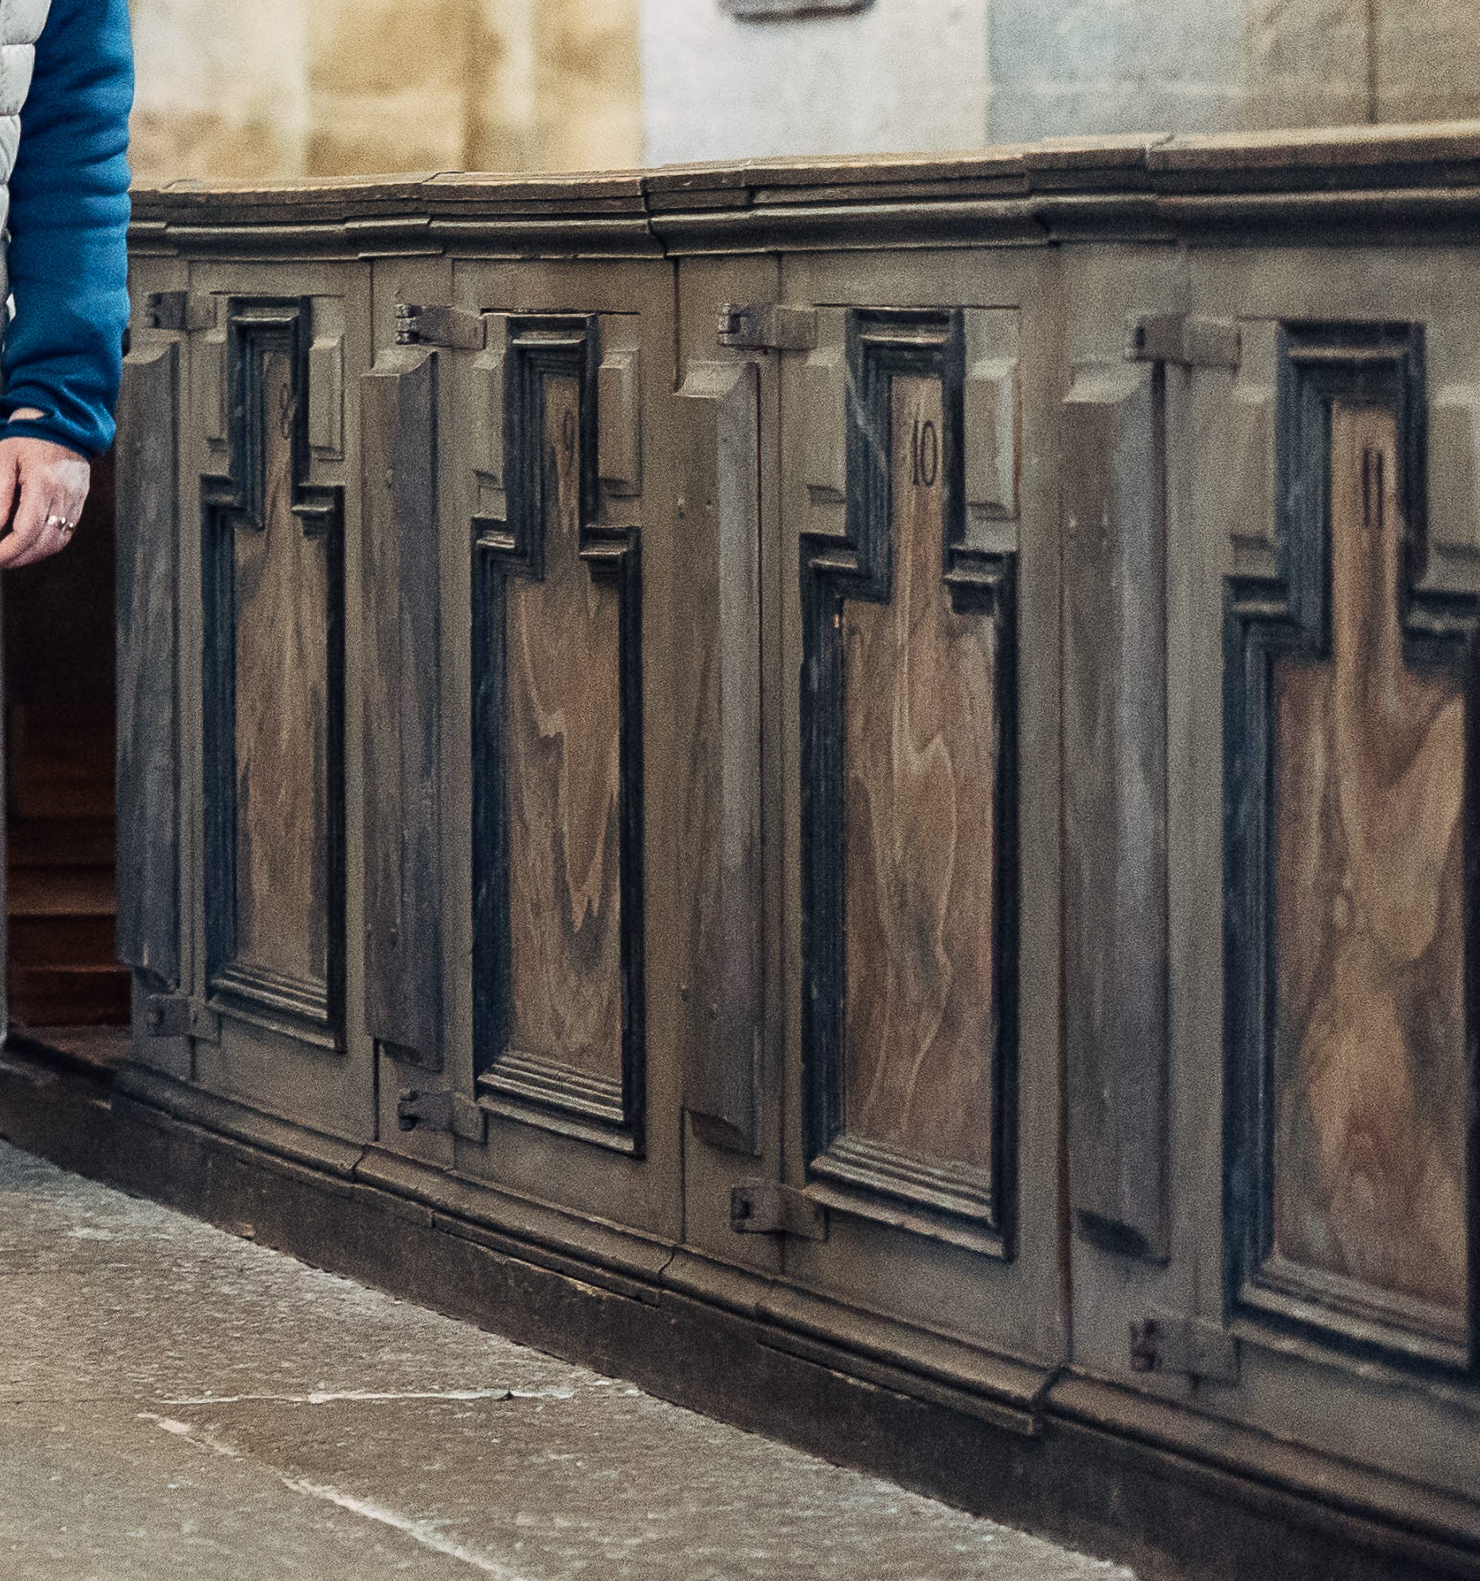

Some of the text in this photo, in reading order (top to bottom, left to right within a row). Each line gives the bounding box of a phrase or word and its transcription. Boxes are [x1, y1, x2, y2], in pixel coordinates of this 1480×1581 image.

[280, 382, 291, 440] 8
[561, 409, 575, 477] 9
[912, 419, 938, 487] 10
[1362, 447, 1384, 528] 11
